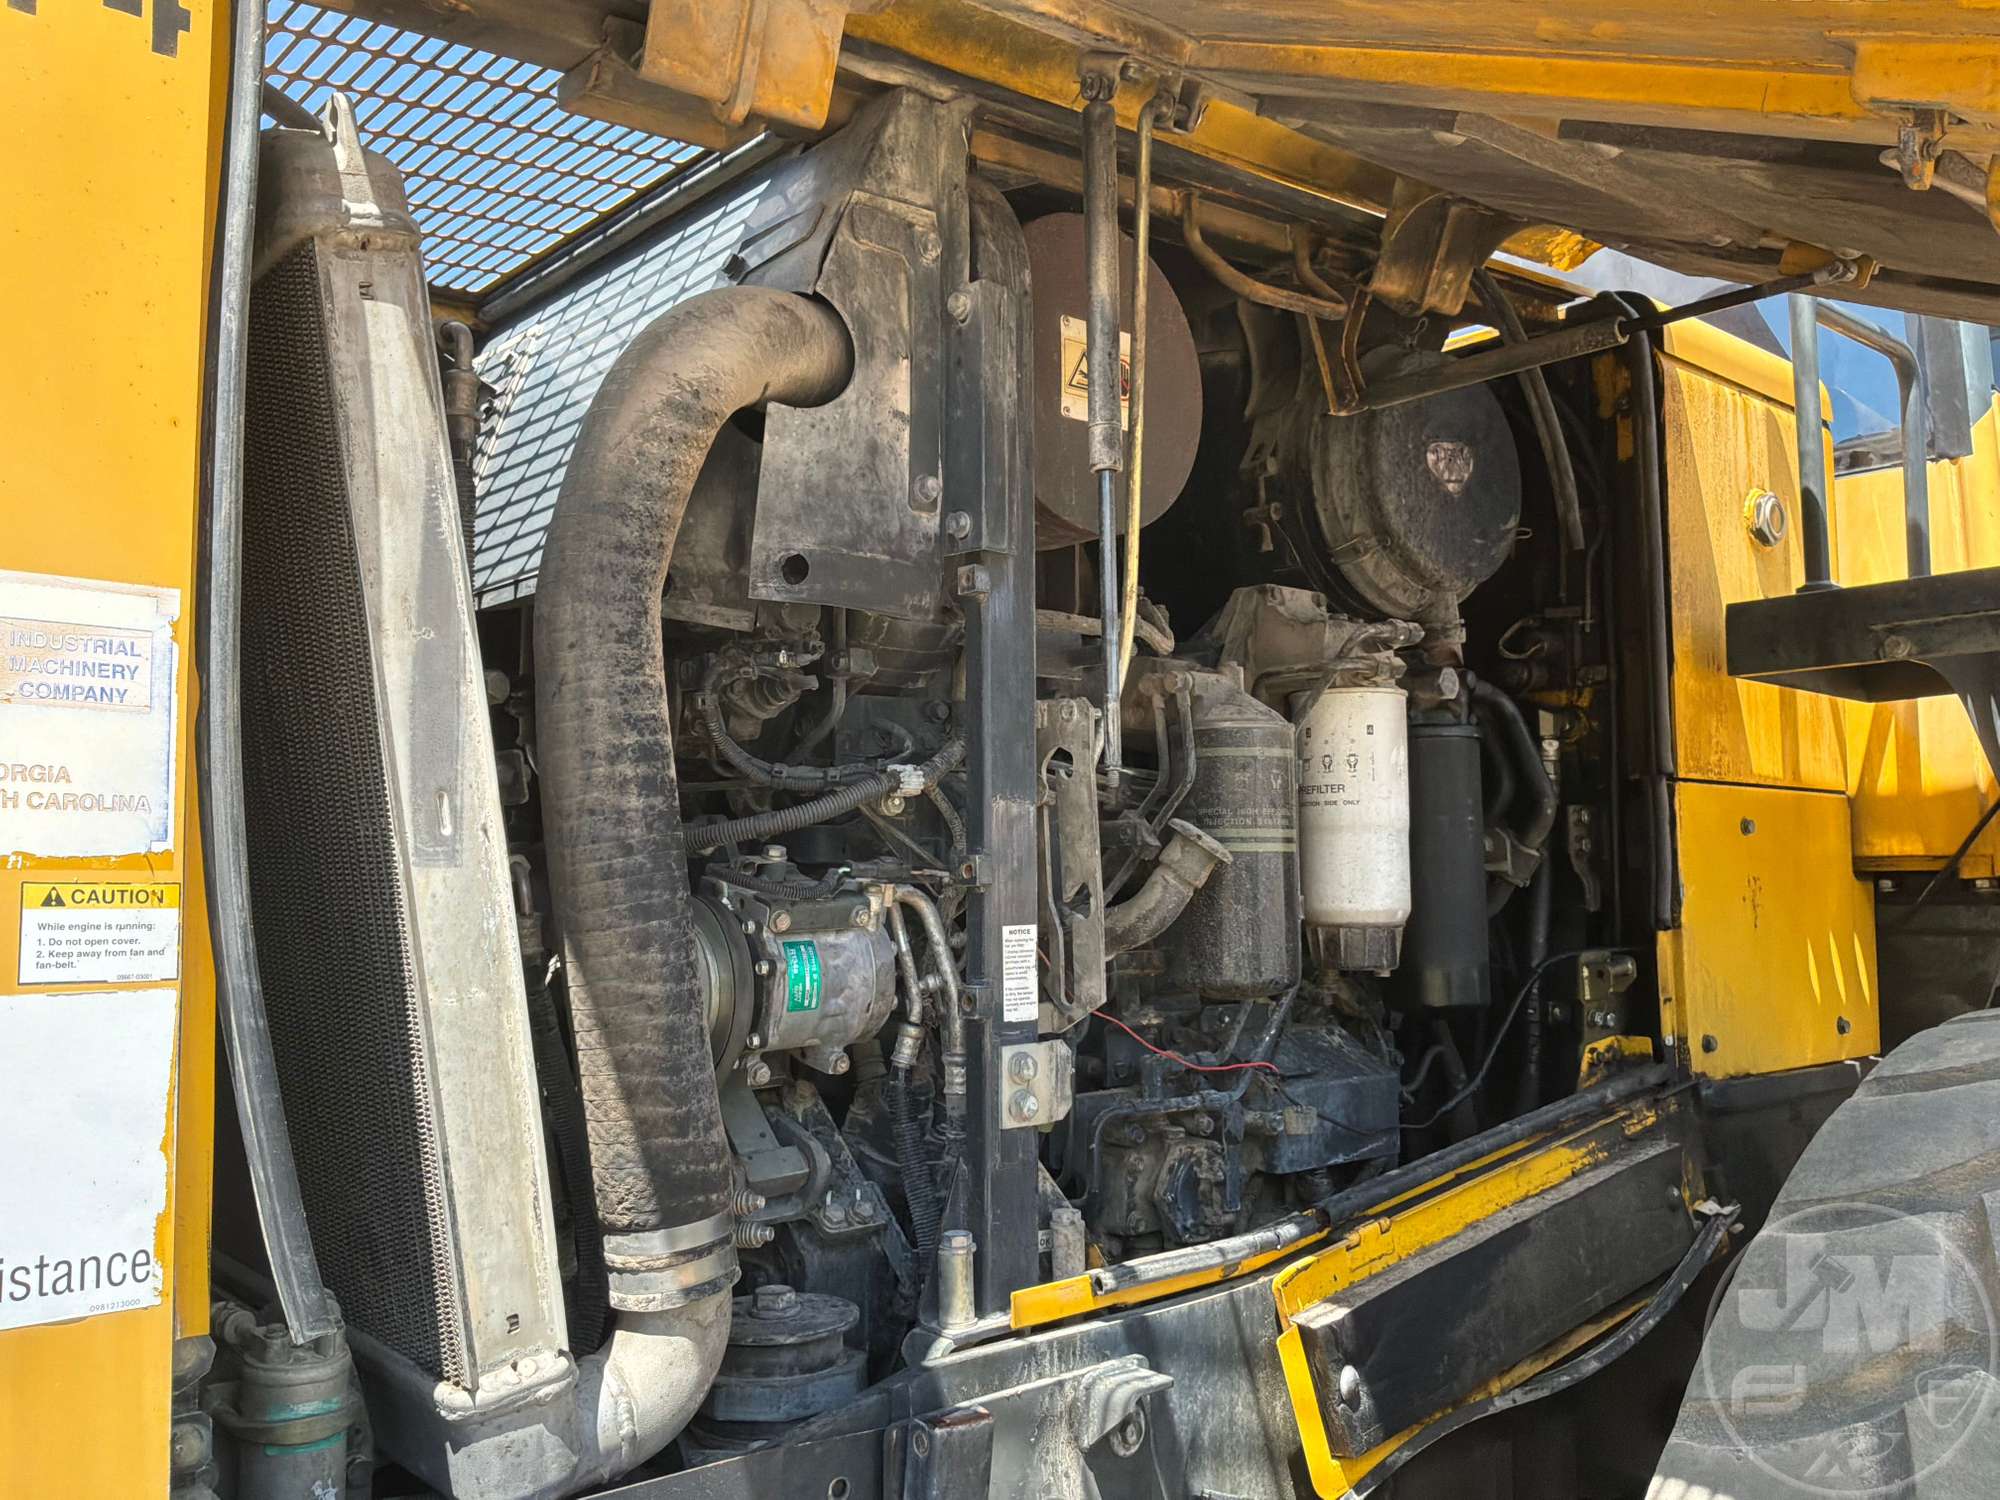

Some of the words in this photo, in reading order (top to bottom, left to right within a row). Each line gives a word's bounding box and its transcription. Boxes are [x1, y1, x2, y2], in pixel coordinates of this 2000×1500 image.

[9, 630, 142, 658] INDUSTRIAL
[9, 655, 139, 681] MACHINERY
[18, 681, 128, 704] COMPANY
[26, 791, 152, 814] CAROLINA
[71, 889, 164, 905] CAUTION
[37, 922, 65, 931] While
[68, 922, 101, 933] engine
[104, 922, 113, 931] is
[115, 923, 156, 932] running:
[37, 938, 46, 947] 1.
[49, 938, 62, 946] Do
[65, 938, 82, 946] not
[84, 938, 109, 948] open
[111, 938, 141, 946] cover.
[36, 950, 45, 959] 2.
[48, 950, 74, 960] Keep
[76, 950, 101, 960] away
[104, 948, 127, 957] from
[130, 948, 145, 957] fan
[147, 948, 165, 957] and
[36, 960, 77, 970] fan-belt.
[0, 1248, 151, 1303] istance
